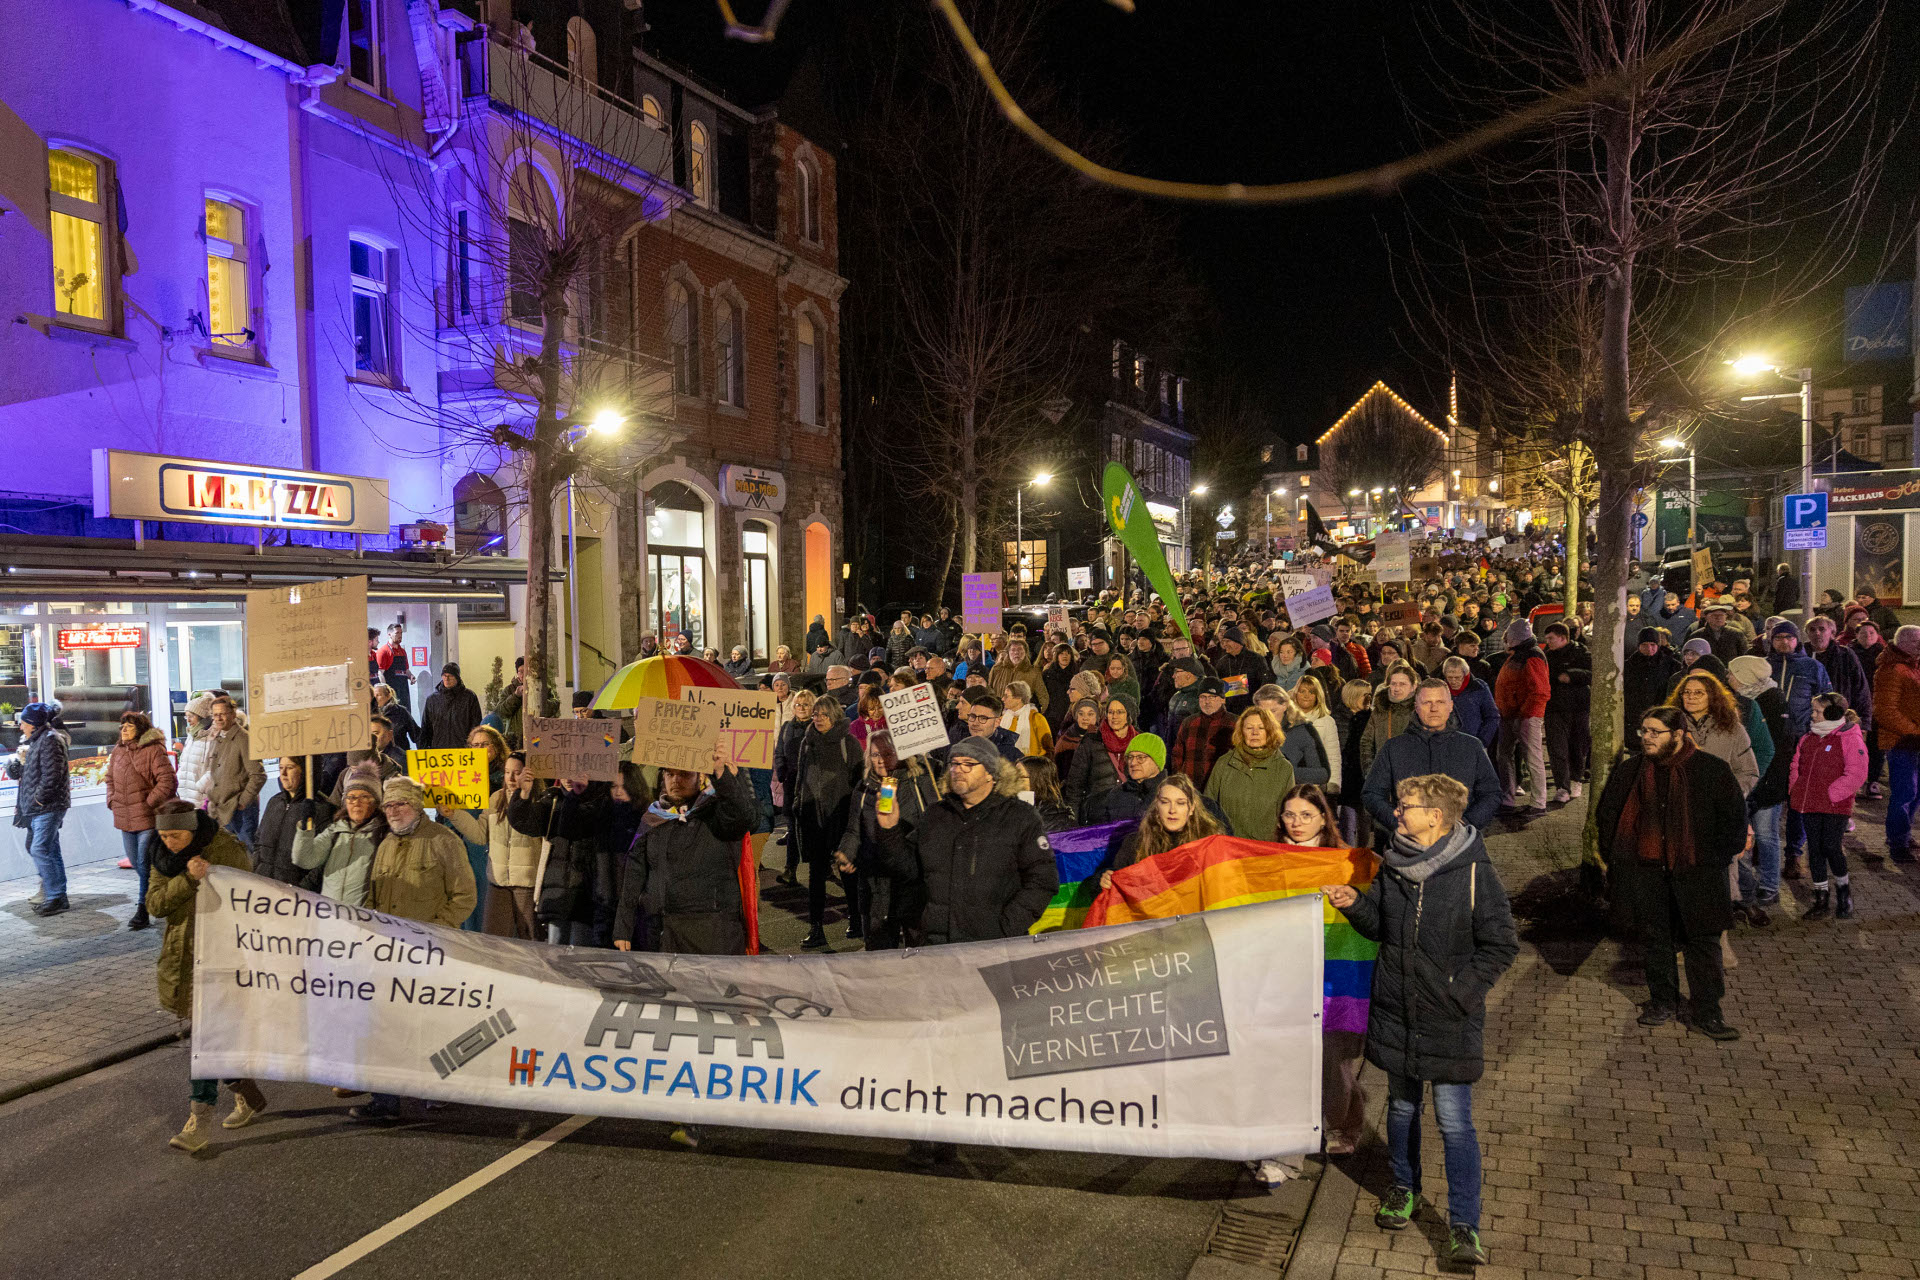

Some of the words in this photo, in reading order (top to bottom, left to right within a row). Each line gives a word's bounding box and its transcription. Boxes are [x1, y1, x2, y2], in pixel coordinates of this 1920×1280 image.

[1832, 491, 1884, 503] BACKHAUS
[1795, 499, 1818, 525] P
[654, 700, 701, 720] RAVER
[884, 693, 911, 709] OMI
[888, 701, 936, 724] GEGEN
[256, 719, 310, 752] STOPPT
[531, 719, 613, 733] MENSCHENRECHTE
[648, 718, 706, 738] GEGEN
[891, 715, 939, 737] RECHTS
[550, 733, 588, 749] STATT
[415, 751, 455, 770] Hass
[459, 751, 475, 766] ist
[642, 739, 714, 770] RECHTS
[418, 770, 468, 787] KEINE
[423, 788, 482, 808] Meinung
[1047, 942, 1139, 971] KEINE
[1012, 964, 1122, 999] RÄUME
[1132, 951, 1193, 981] FÜR
[236, 969, 280, 991] um
[290, 969, 376, 1001] deine
[390, 977, 494, 1009] Nazis!
[1049, 990, 1166, 1027] RECHTE
[1006, 1020, 1218, 1066] VERNETZUNG
[840, 1077, 948, 1115] dicht
[965, 1087, 1159, 1130] machen!
